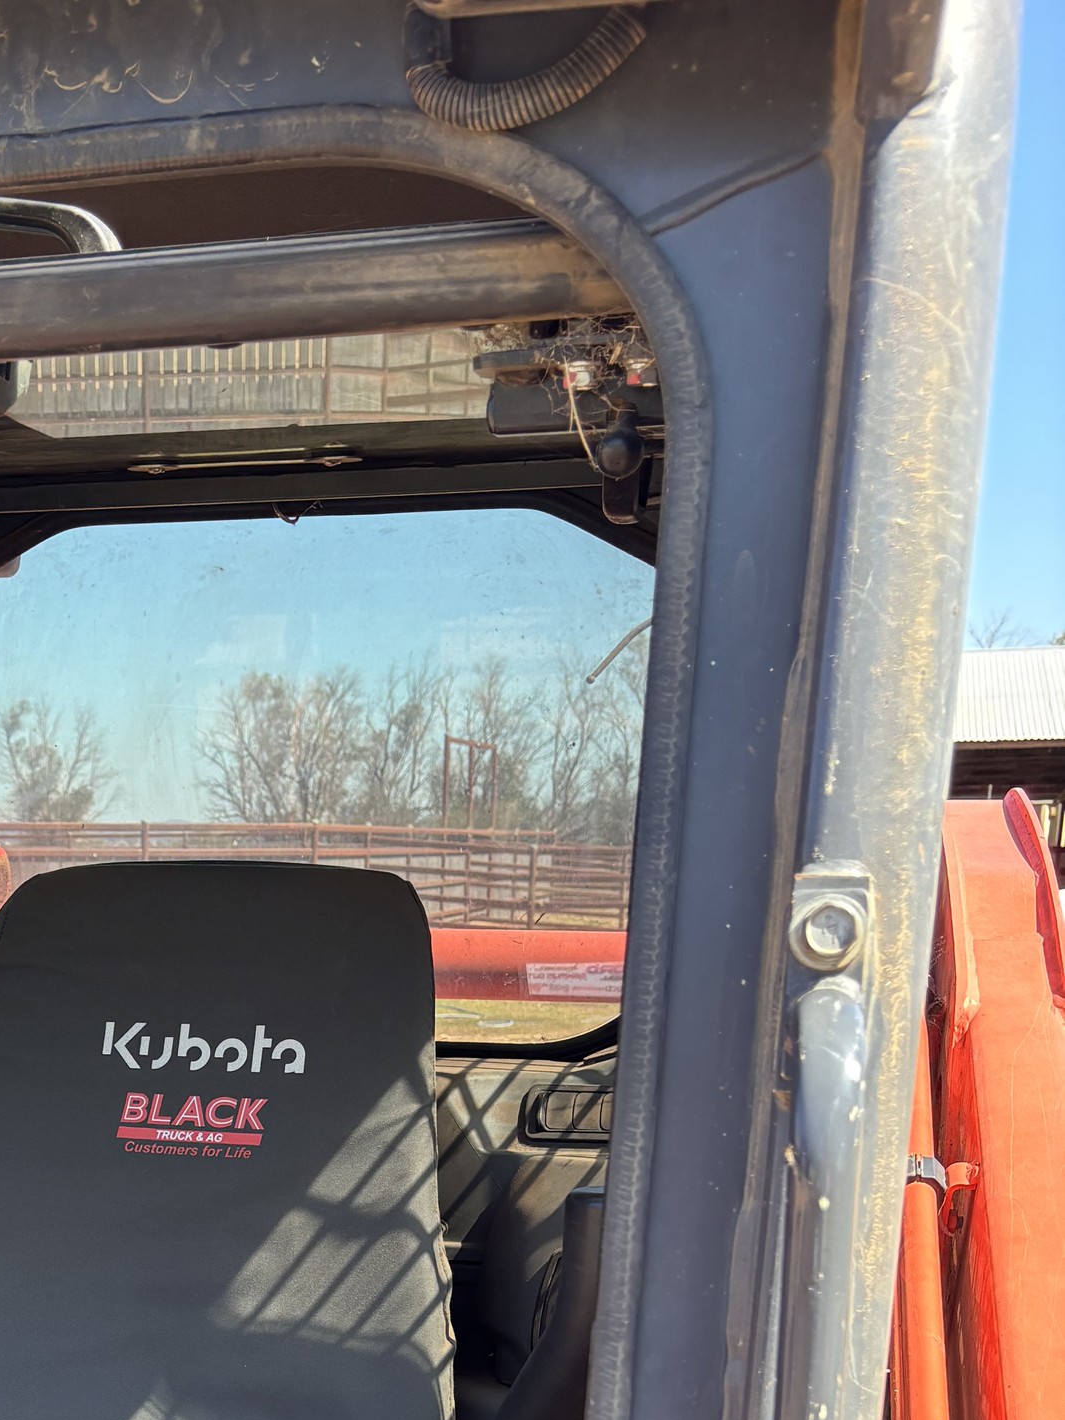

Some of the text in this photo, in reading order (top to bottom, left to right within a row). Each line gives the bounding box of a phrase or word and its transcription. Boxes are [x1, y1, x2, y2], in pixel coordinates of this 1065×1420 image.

[101, 1021, 306, 1074] Kubota
[120, 1092, 268, 1131] BLACK
[124, 1141, 252, 1160] Customers for Life
[155, 1130, 224, 1143] TRUCK & AG
